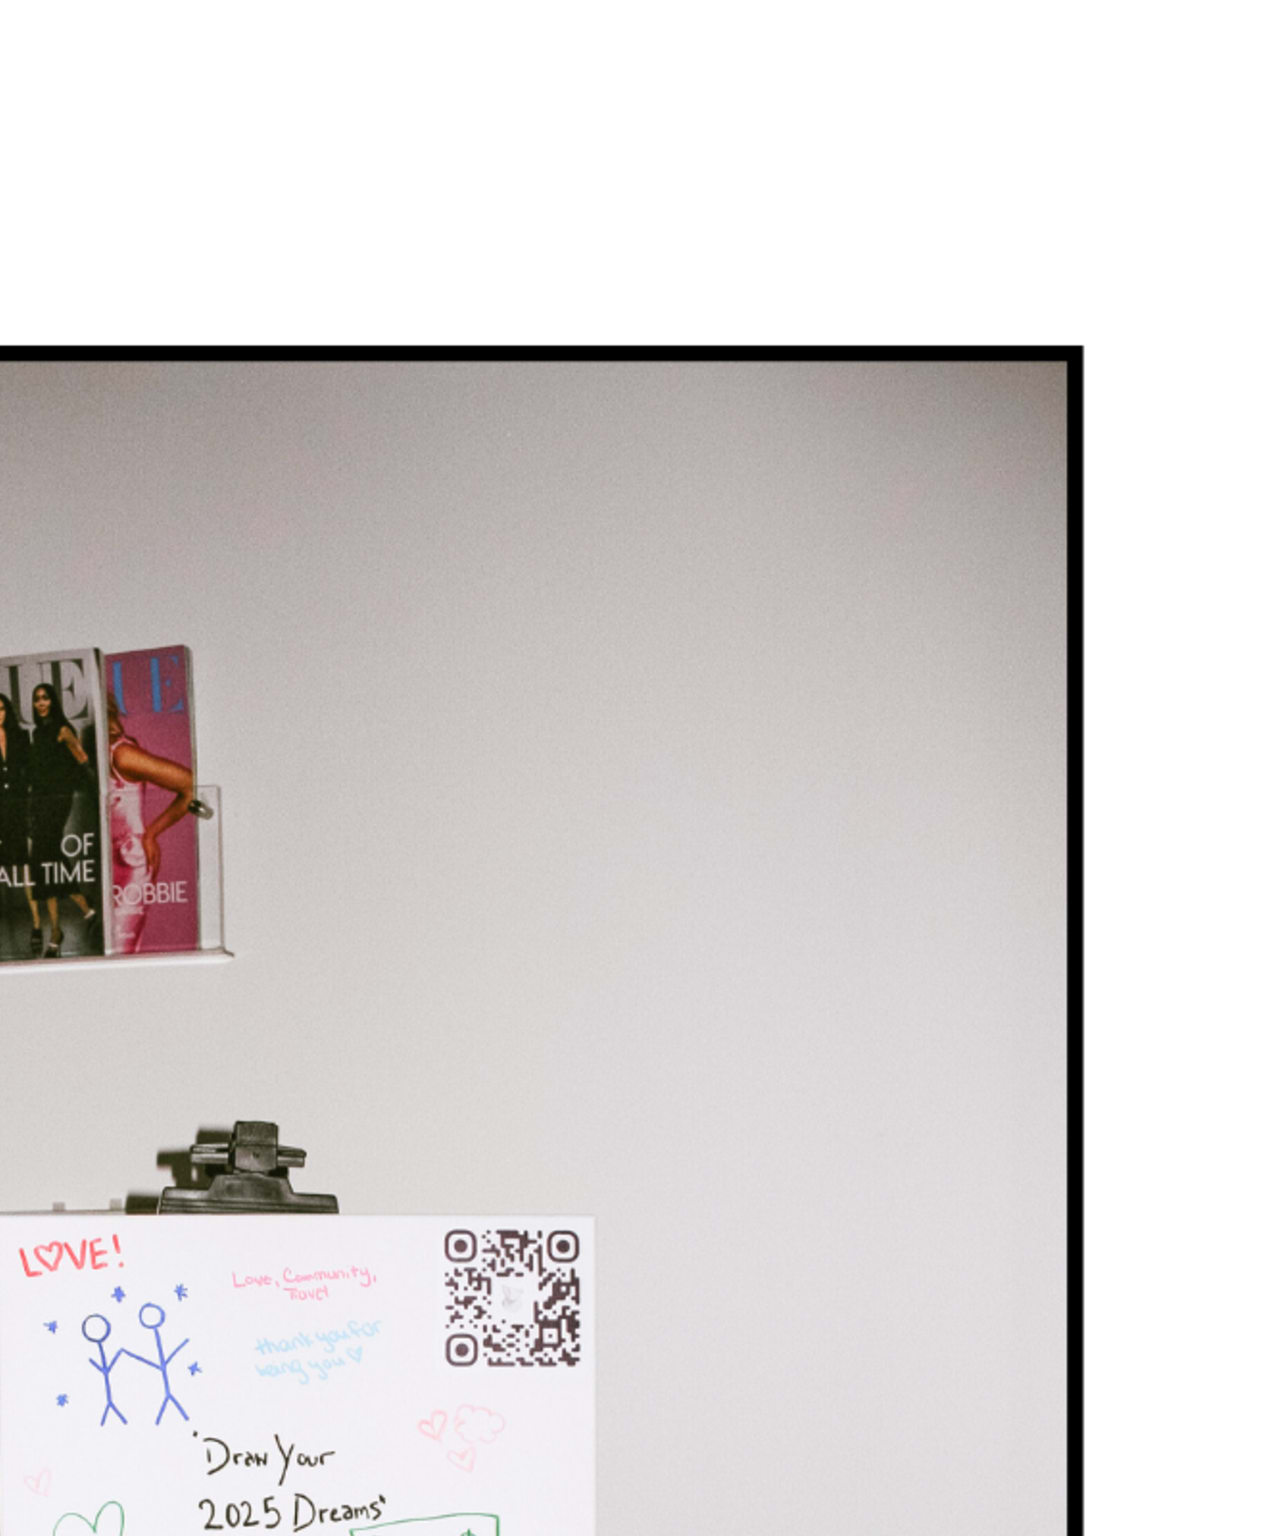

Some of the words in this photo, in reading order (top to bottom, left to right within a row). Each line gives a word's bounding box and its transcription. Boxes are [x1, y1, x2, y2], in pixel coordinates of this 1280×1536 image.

[60, 833, 95, 857] OF
[41, 860, 96, 885] TIME
[111, 880, 188, 906] ROBBIE
[232, 1271, 280, 1289] Love,
[282, 1264, 377, 1288] Community,
[255, 1331, 313, 1356] thank
[315, 1328, 350, 1354] you
[345, 1320, 383, 1338] for
[307, 1356, 345, 1381] you
[274, 1433, 336, 1486] Your
[198, 1495, 282, 1531] 2025
